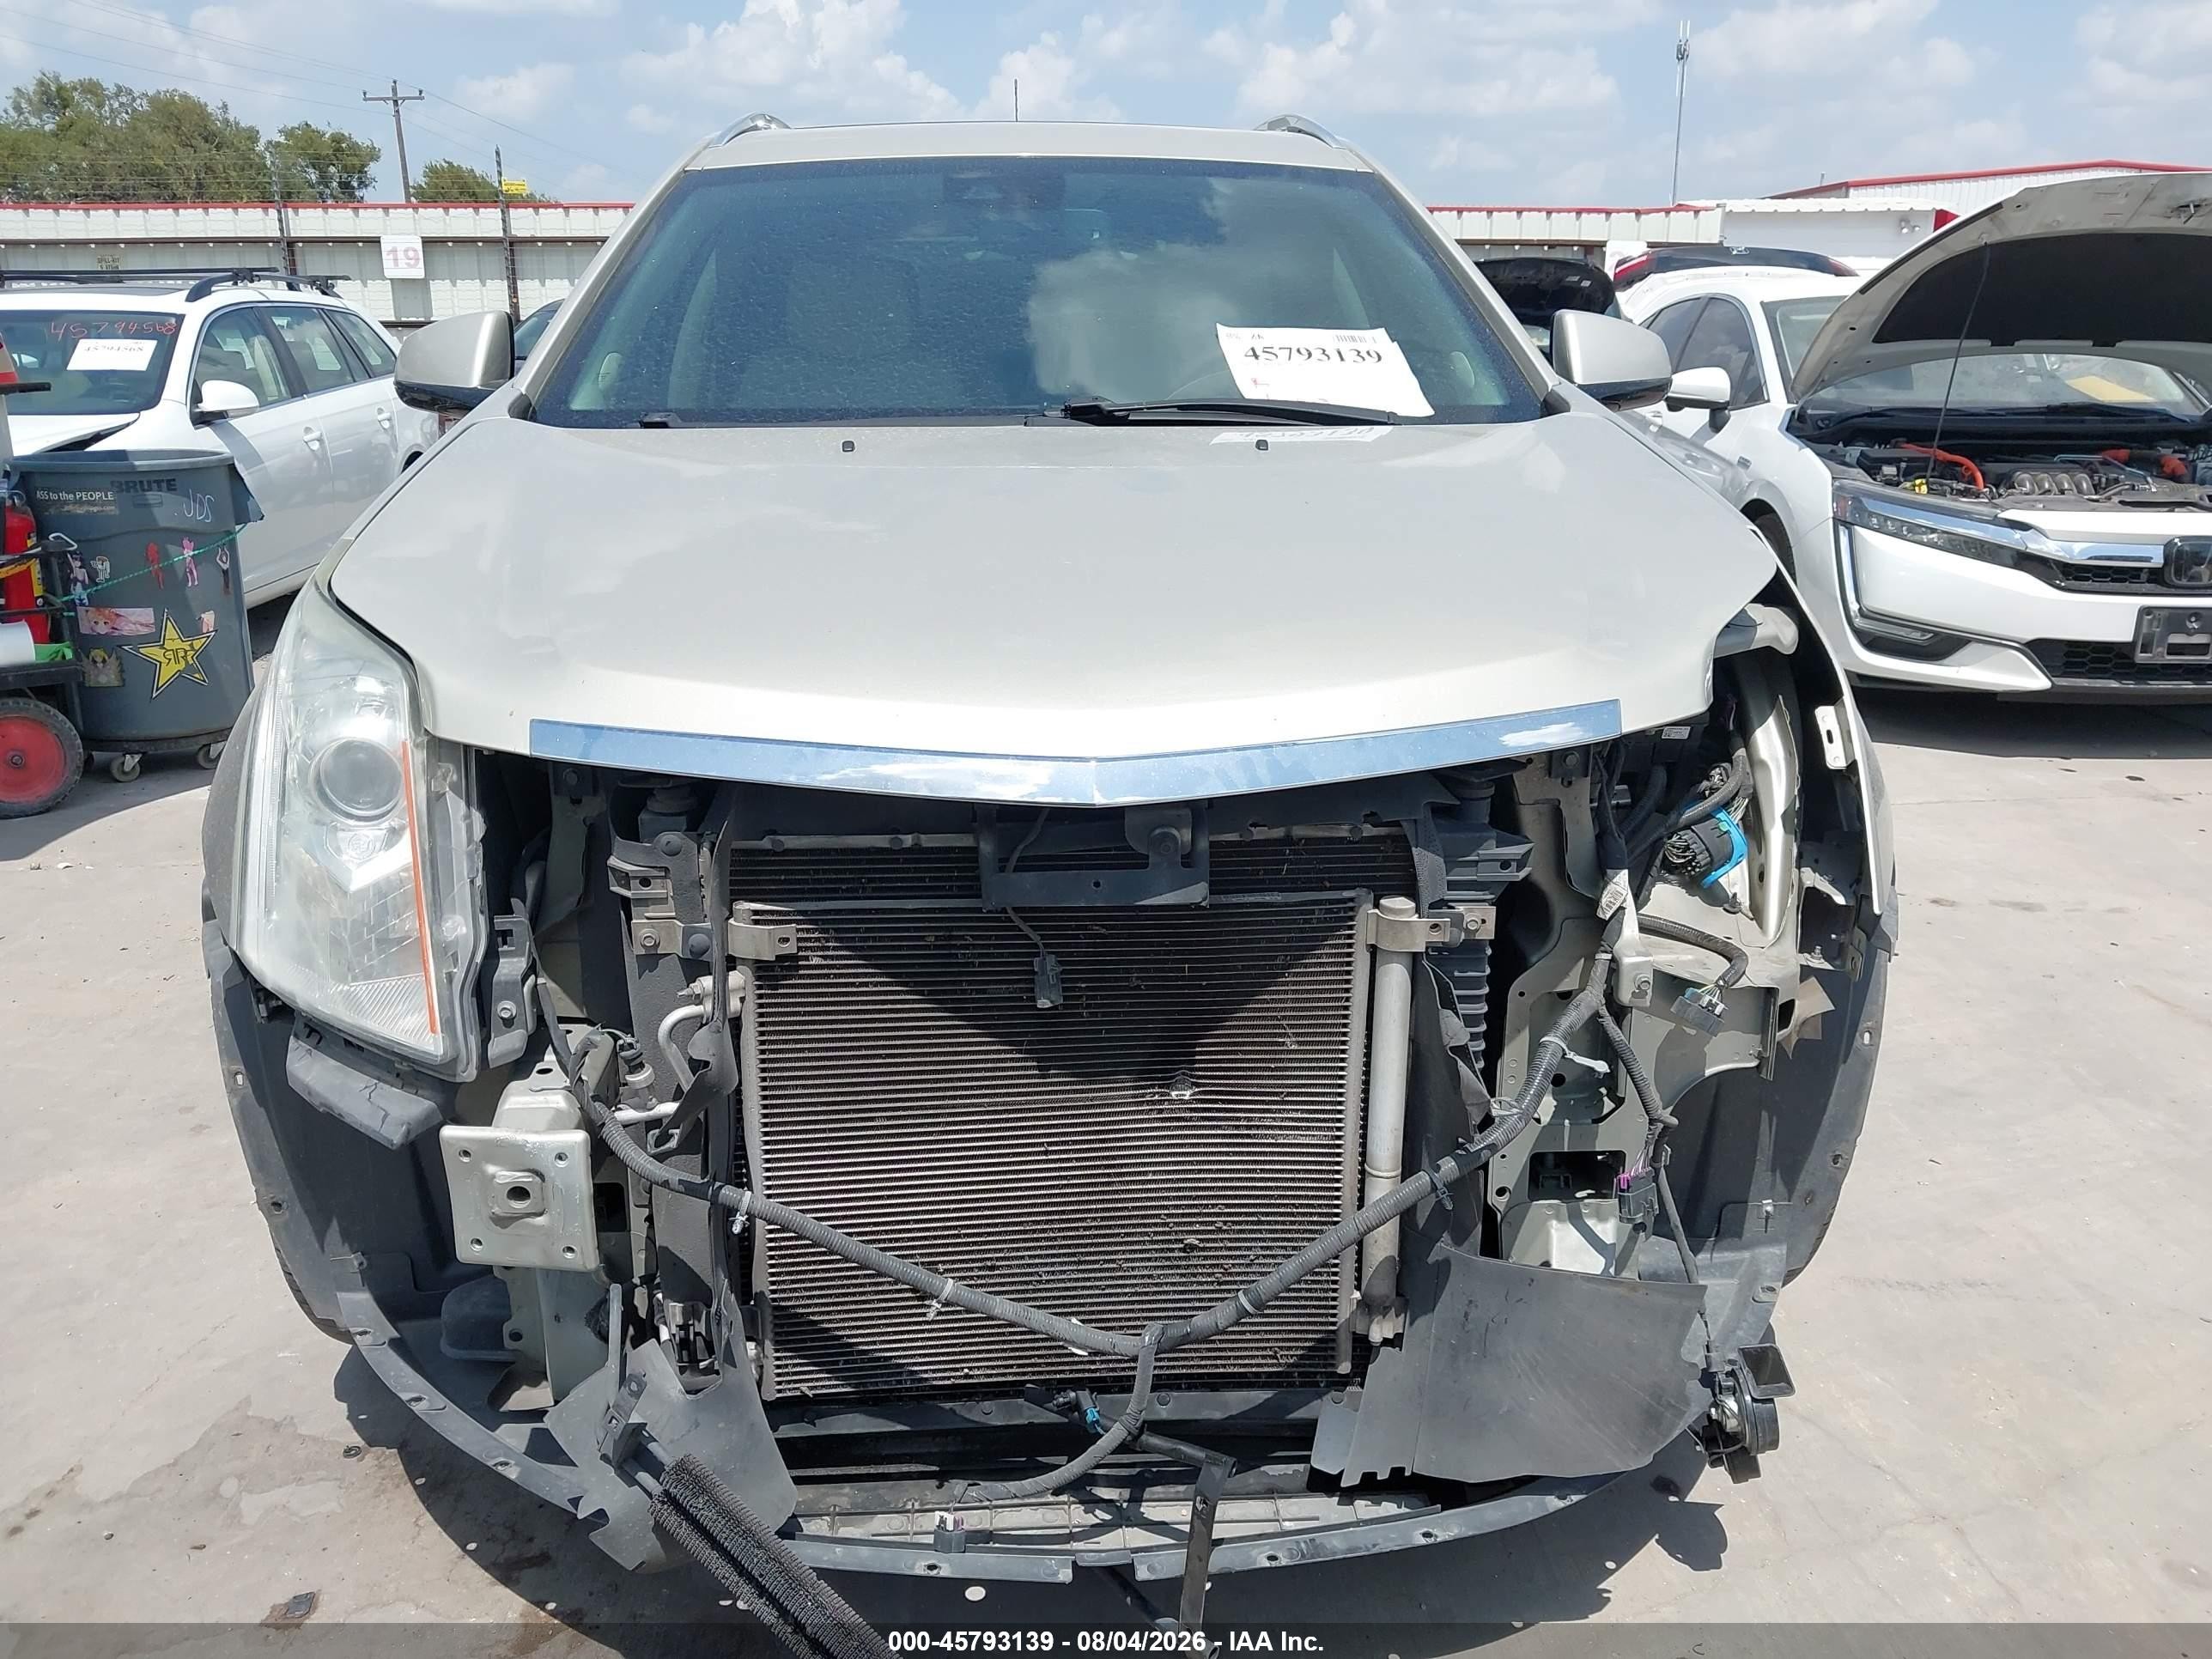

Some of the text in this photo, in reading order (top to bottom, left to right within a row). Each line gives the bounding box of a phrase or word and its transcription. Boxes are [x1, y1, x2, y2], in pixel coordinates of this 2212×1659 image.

[386, 246, 421, 269] 19
[1243, 346, 1382, 364] 45793139
[110, 478, 178, 494] BRUTE
[50, 491, 58, 501] to
[59, 490, 74, 501] the
[76, 491, 114, 501] PEOPLE
